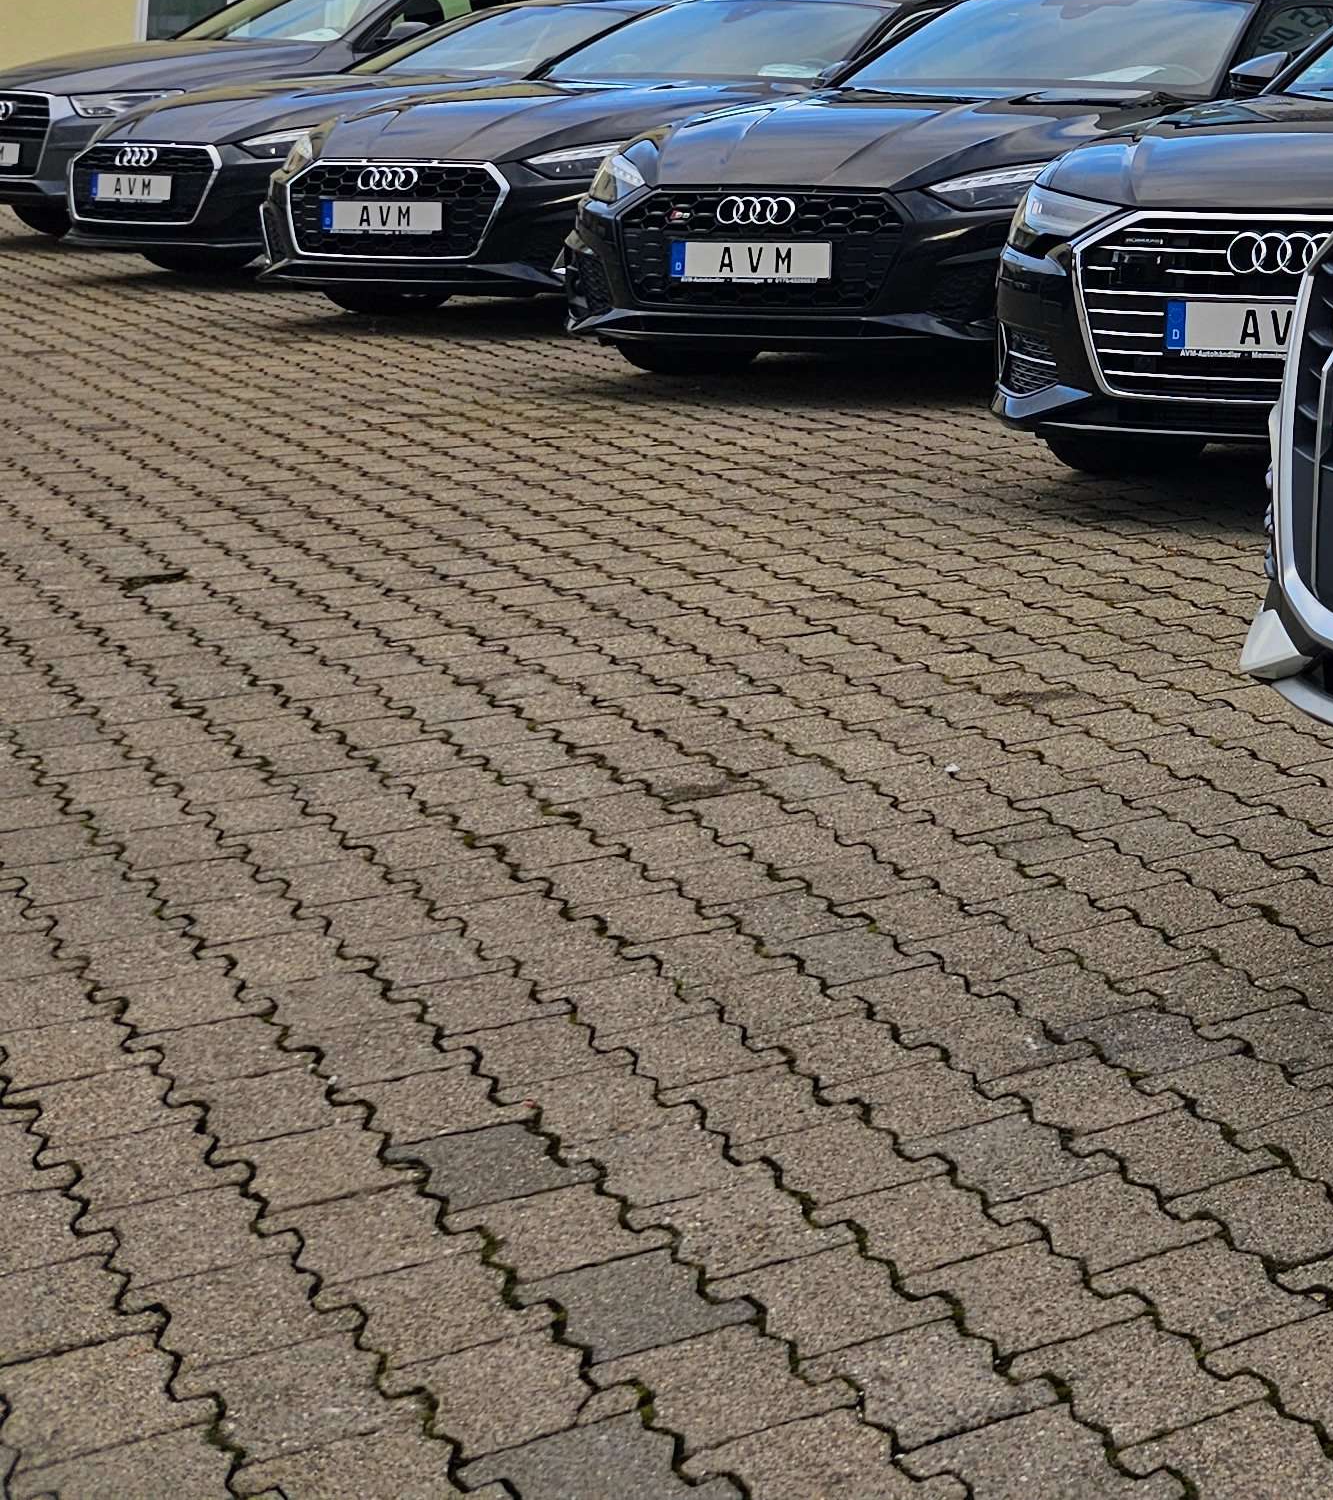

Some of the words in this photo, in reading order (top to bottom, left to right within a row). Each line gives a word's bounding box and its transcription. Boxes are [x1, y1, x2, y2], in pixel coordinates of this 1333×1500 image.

[114, 177, 152, 196] AVM
[359, 205, 410, 227] AVM
[719, 246, 792, 274] AVM
[1172, 329, 1180, 340] D
[1239, 309, 1293, 346] AV
